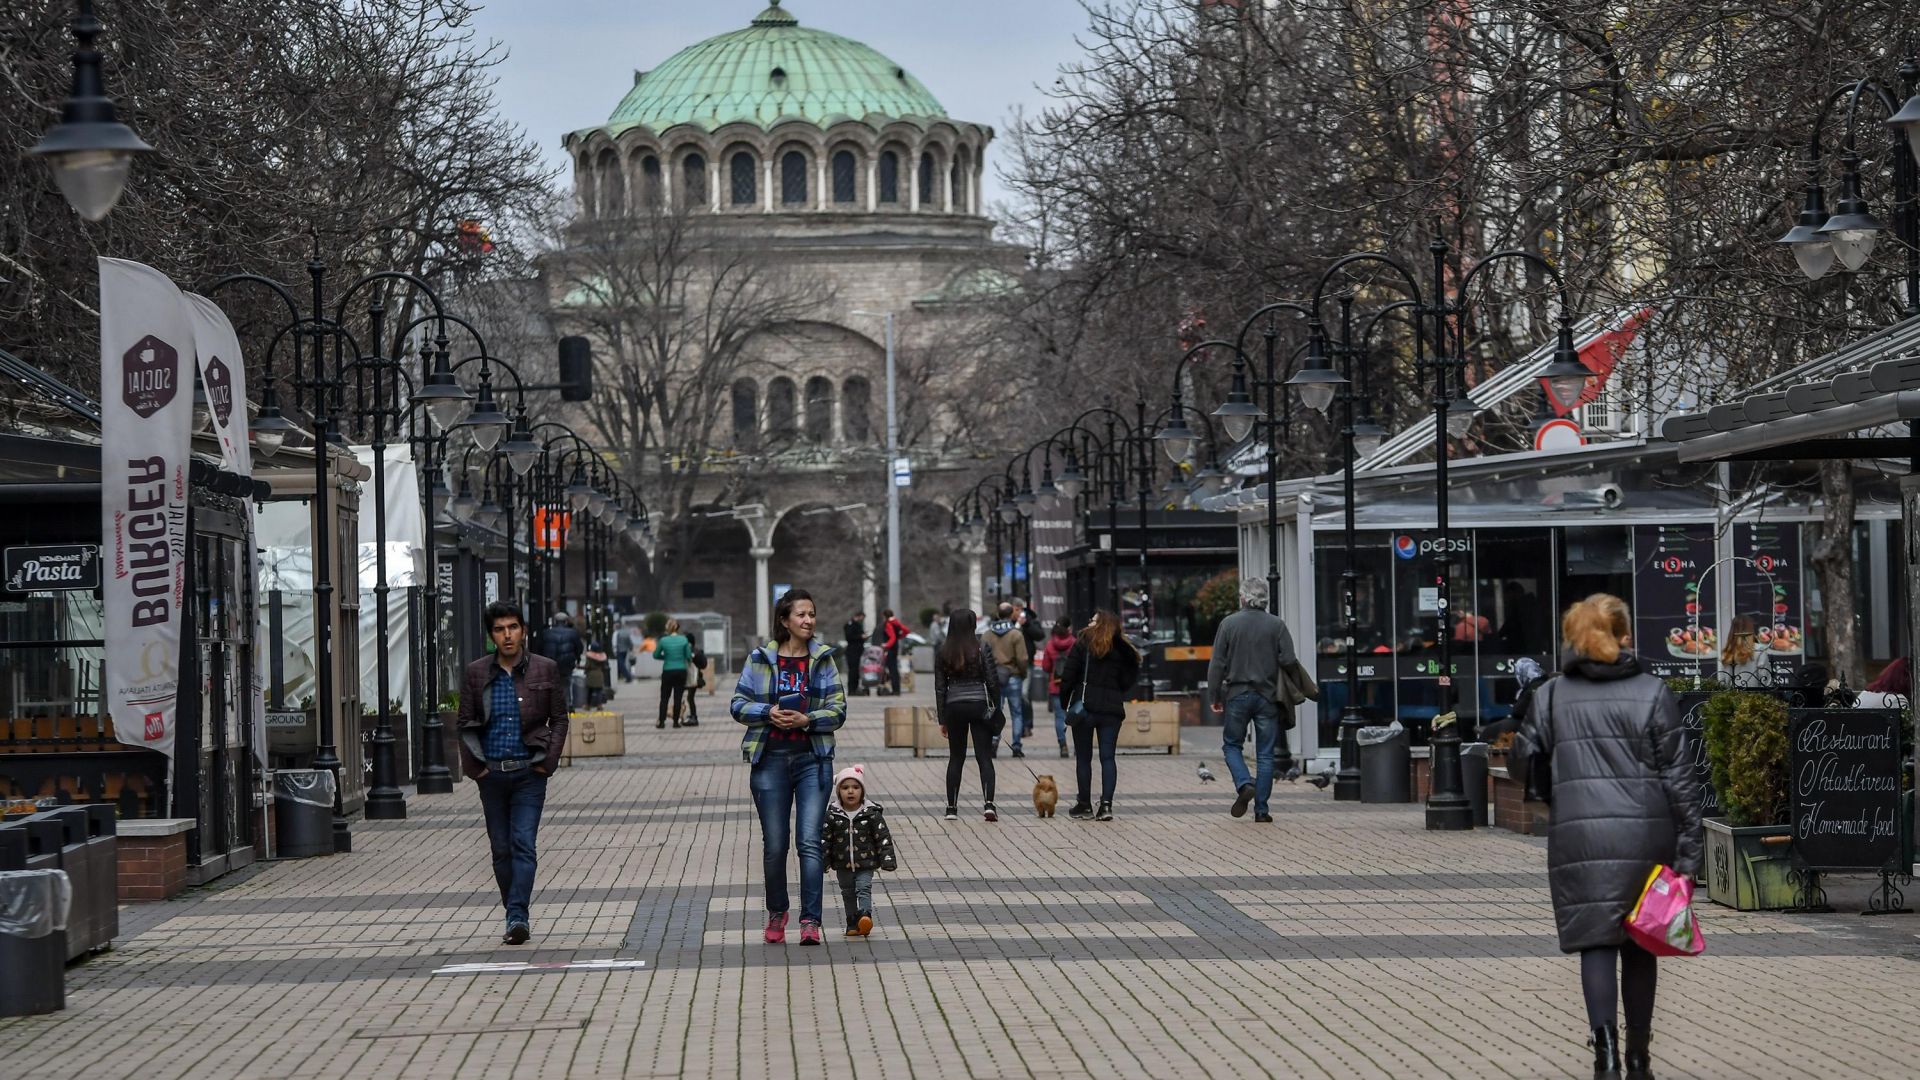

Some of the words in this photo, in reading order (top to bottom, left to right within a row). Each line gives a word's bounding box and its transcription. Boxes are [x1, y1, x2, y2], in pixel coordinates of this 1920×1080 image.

[23, 560, 82, 581] Pasta
[39, 554, 81, 562] HOMEMADE
[439, 562, 453, 604] PIZZA
[1798, 719, 1891, 753] Restaurant
[1869, 806, 1895, 842] food
